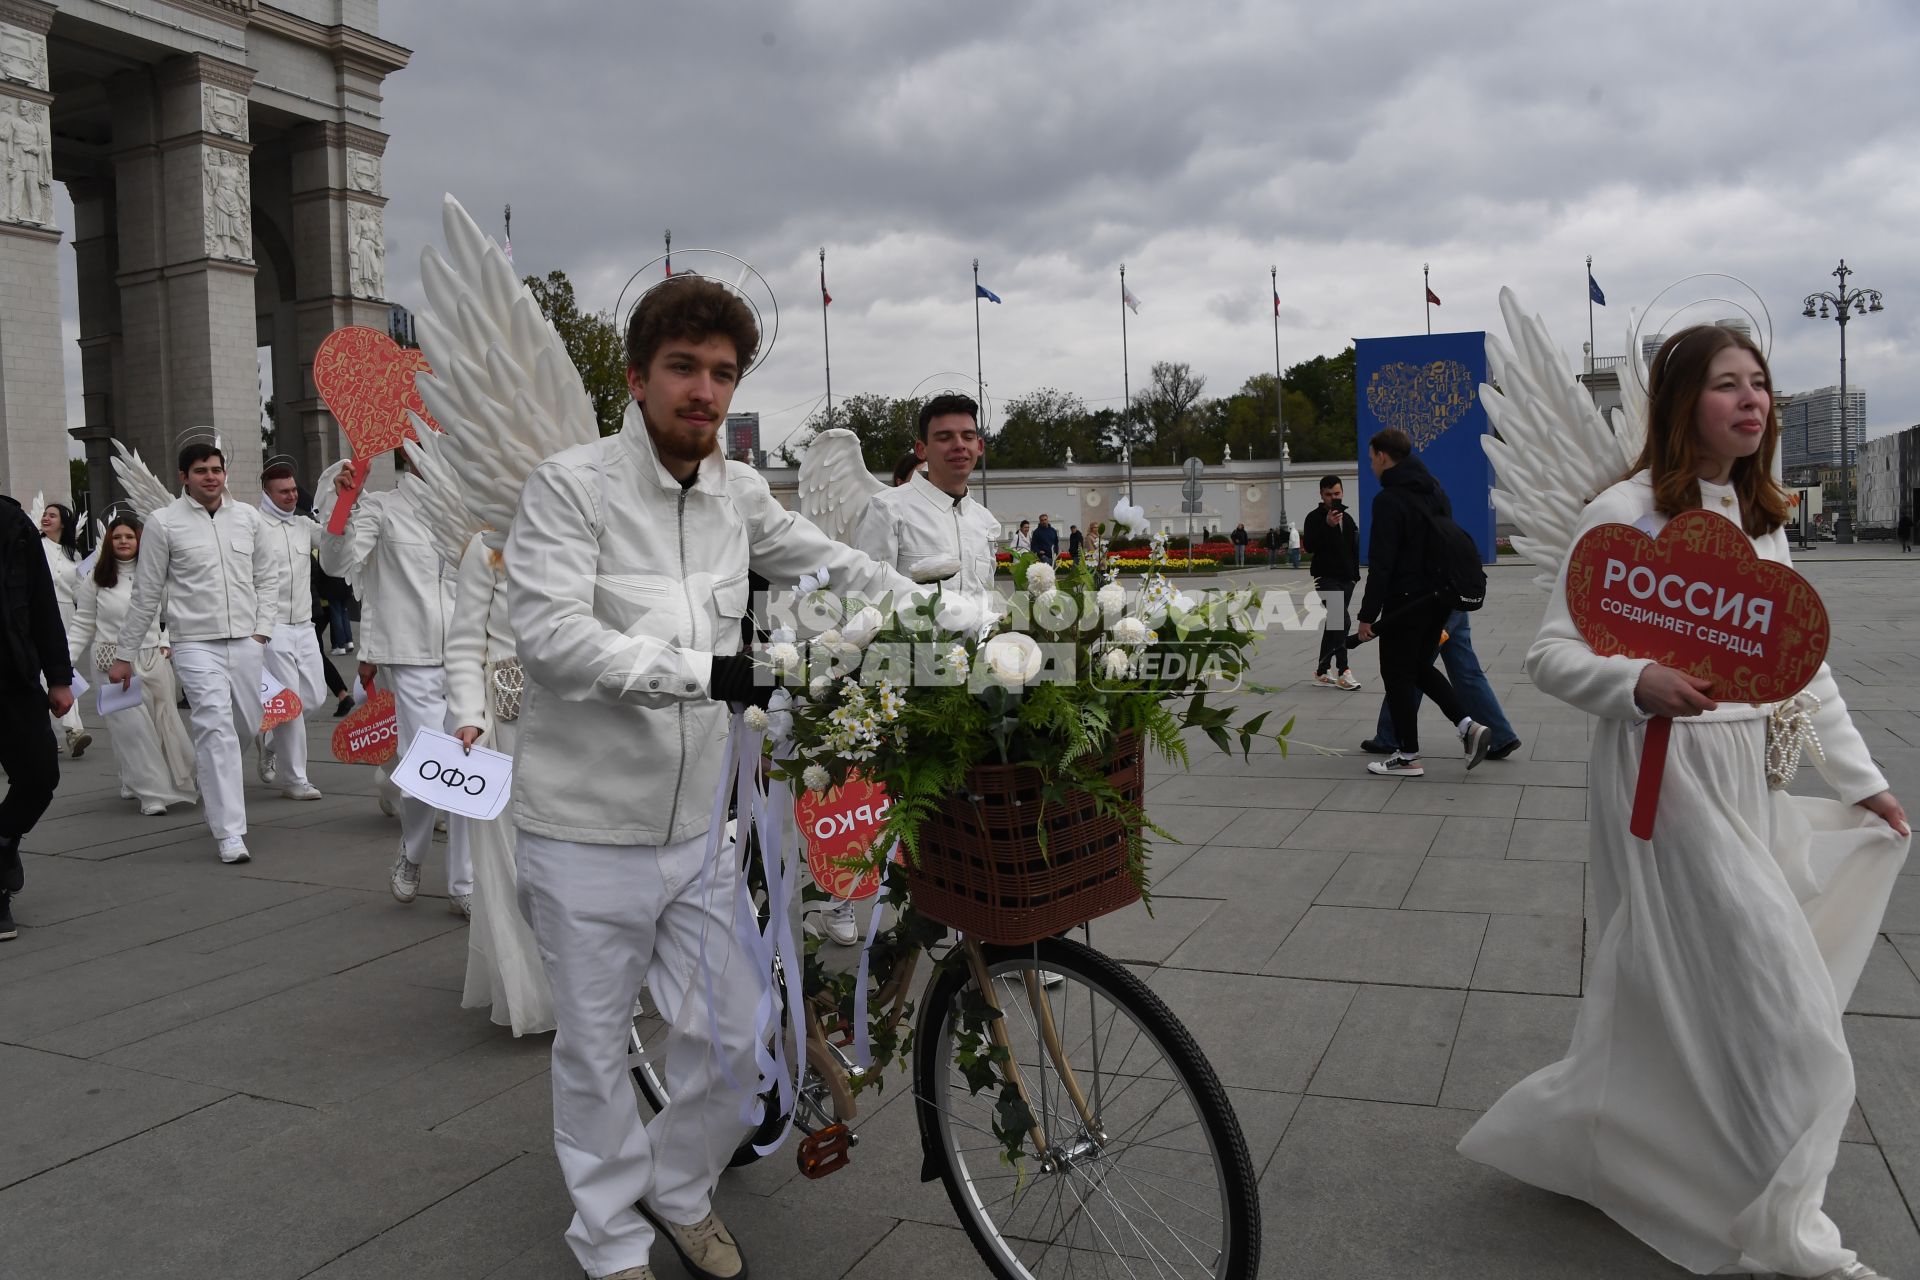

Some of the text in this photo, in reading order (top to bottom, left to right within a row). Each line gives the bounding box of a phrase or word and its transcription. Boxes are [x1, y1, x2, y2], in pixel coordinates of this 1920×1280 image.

[1603, 558, 1774, 635] РОССИЯ
[1600, 597, 1764, 658] СОЕДИНЯЕТ СЕРДЦА
[350, 723, 398, 752] ОССИЯ
[419, 760, 486, 796] СФО
[815, 798, 892, 839] РЬКО
